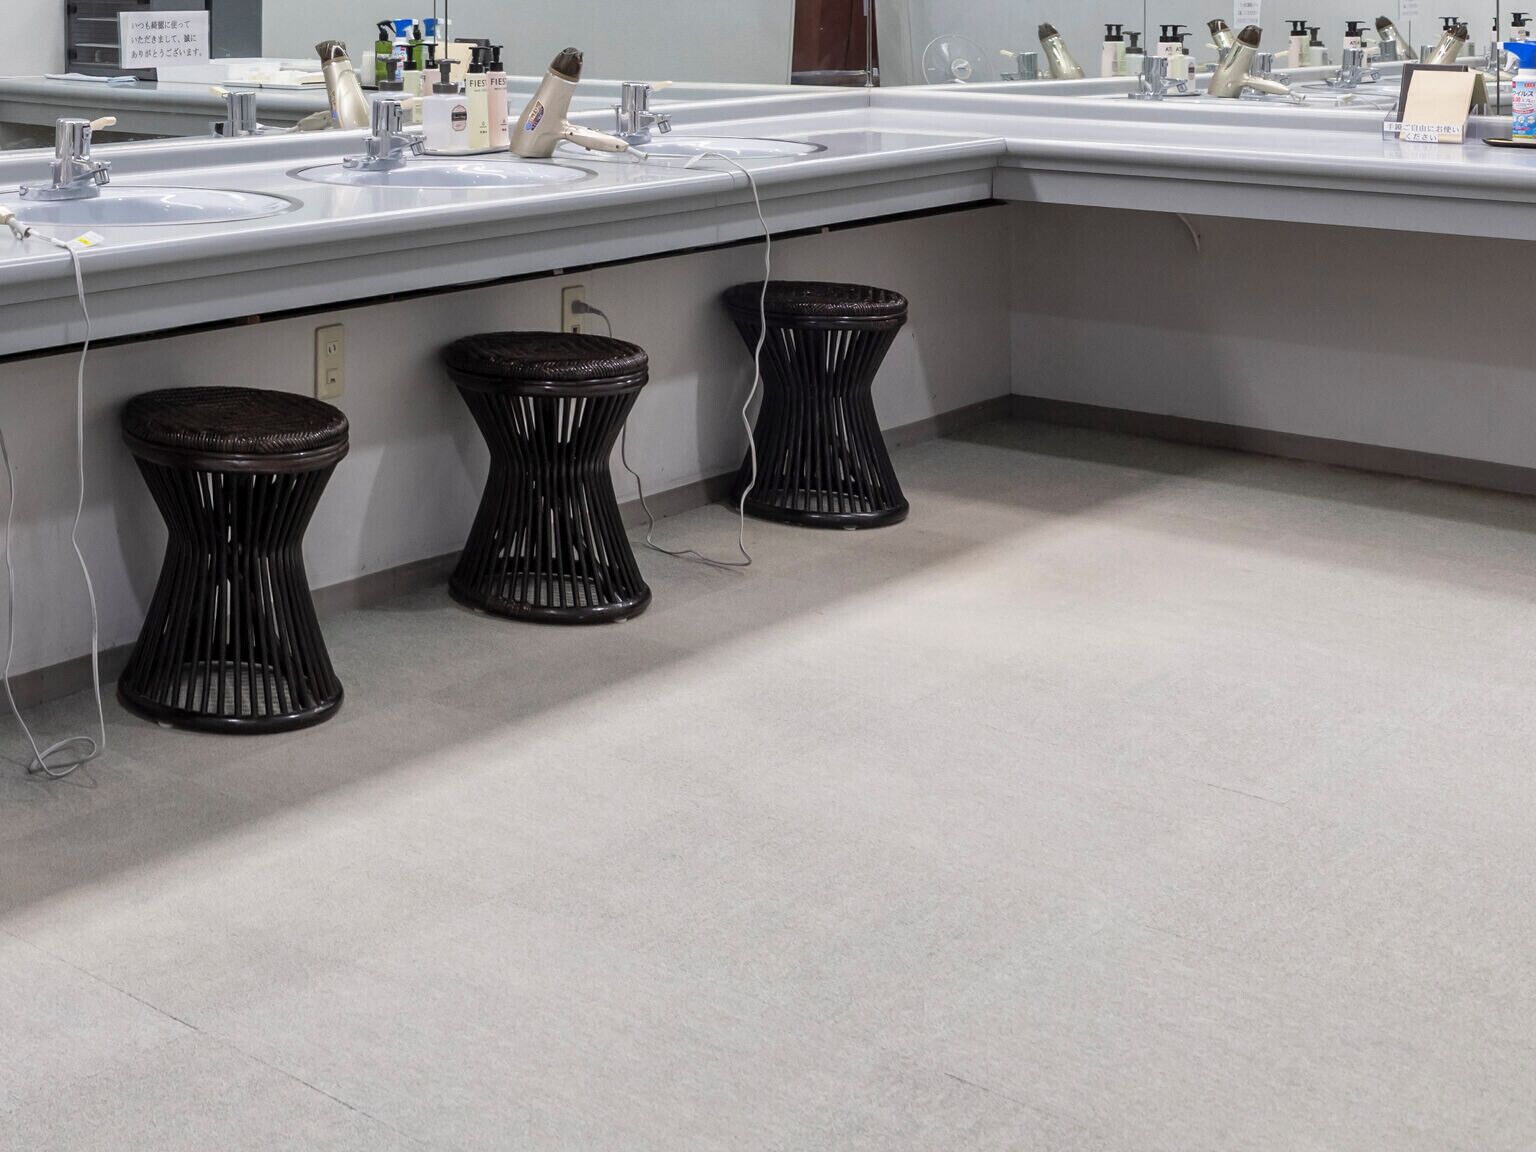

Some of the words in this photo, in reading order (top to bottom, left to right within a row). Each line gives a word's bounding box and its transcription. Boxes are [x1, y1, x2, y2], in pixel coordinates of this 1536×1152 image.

[469, 79, 486, 87] FIES
[490, 78, 507, 86] FIES
[1406, 132, 1437, 141] ください
